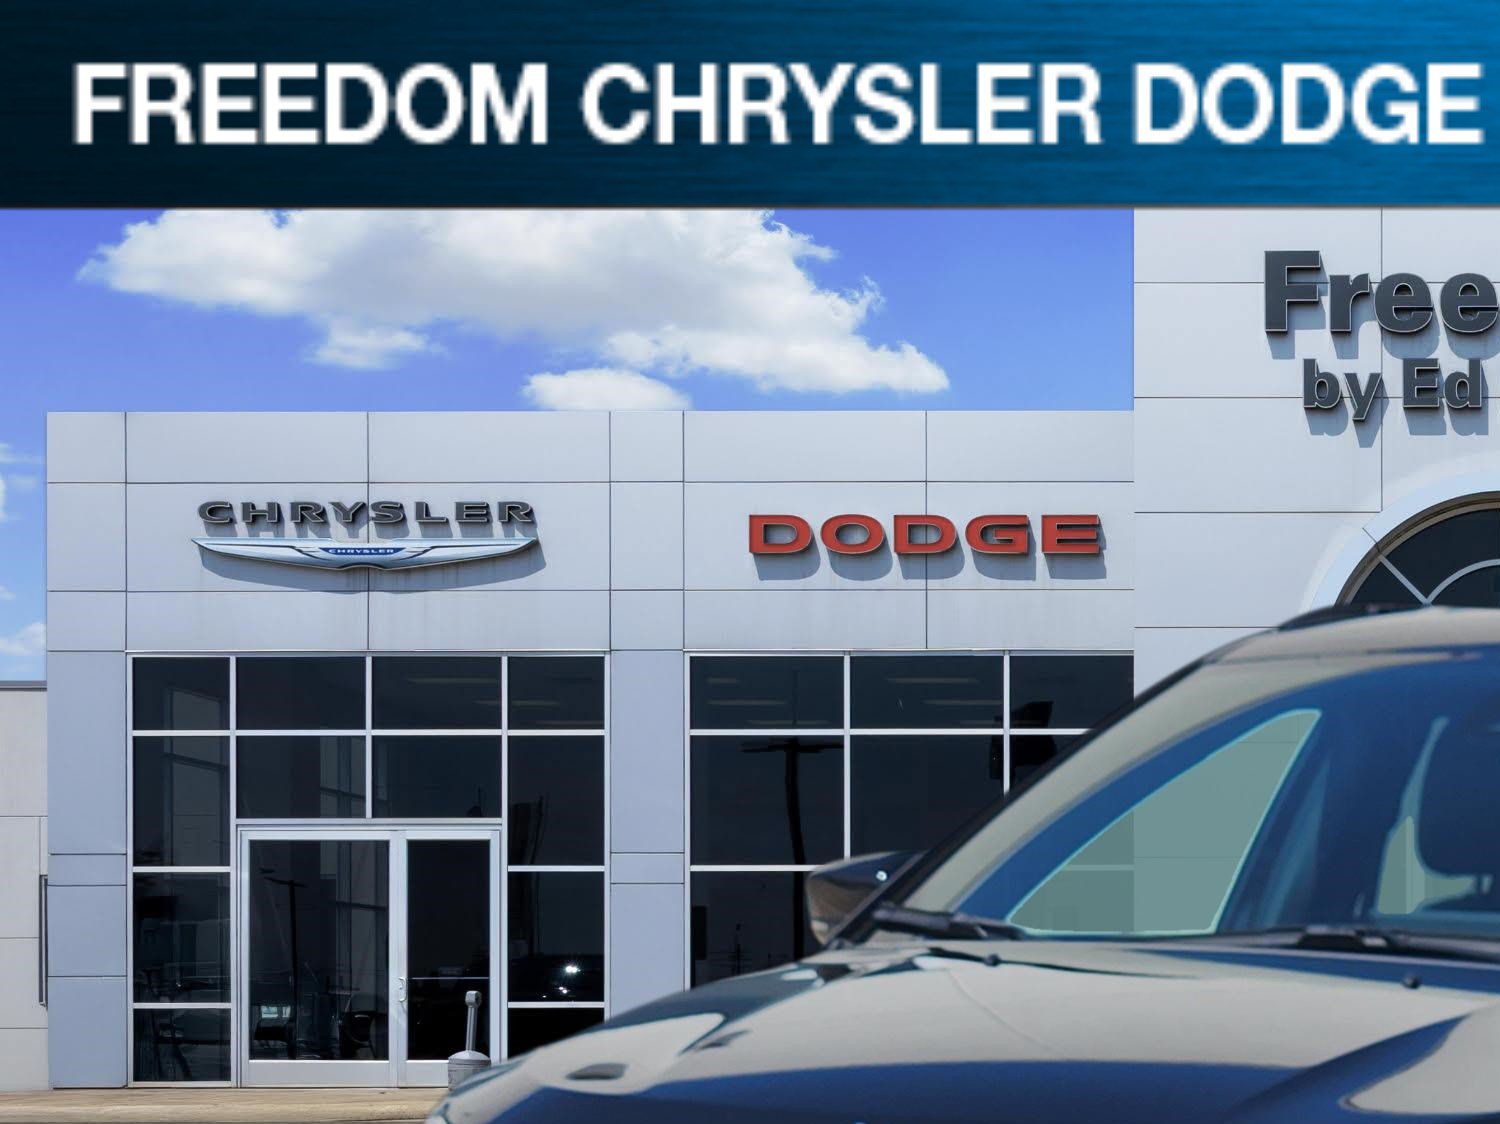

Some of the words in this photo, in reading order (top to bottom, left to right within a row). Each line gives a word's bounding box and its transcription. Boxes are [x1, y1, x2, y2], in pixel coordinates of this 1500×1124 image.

[1302, 358, 1383, 421] by
[1402, 357, 1483, 409] Ed
[197, 500, 534, 524] CHRYSLER
[748, 513, 1101, 555] DODGE
